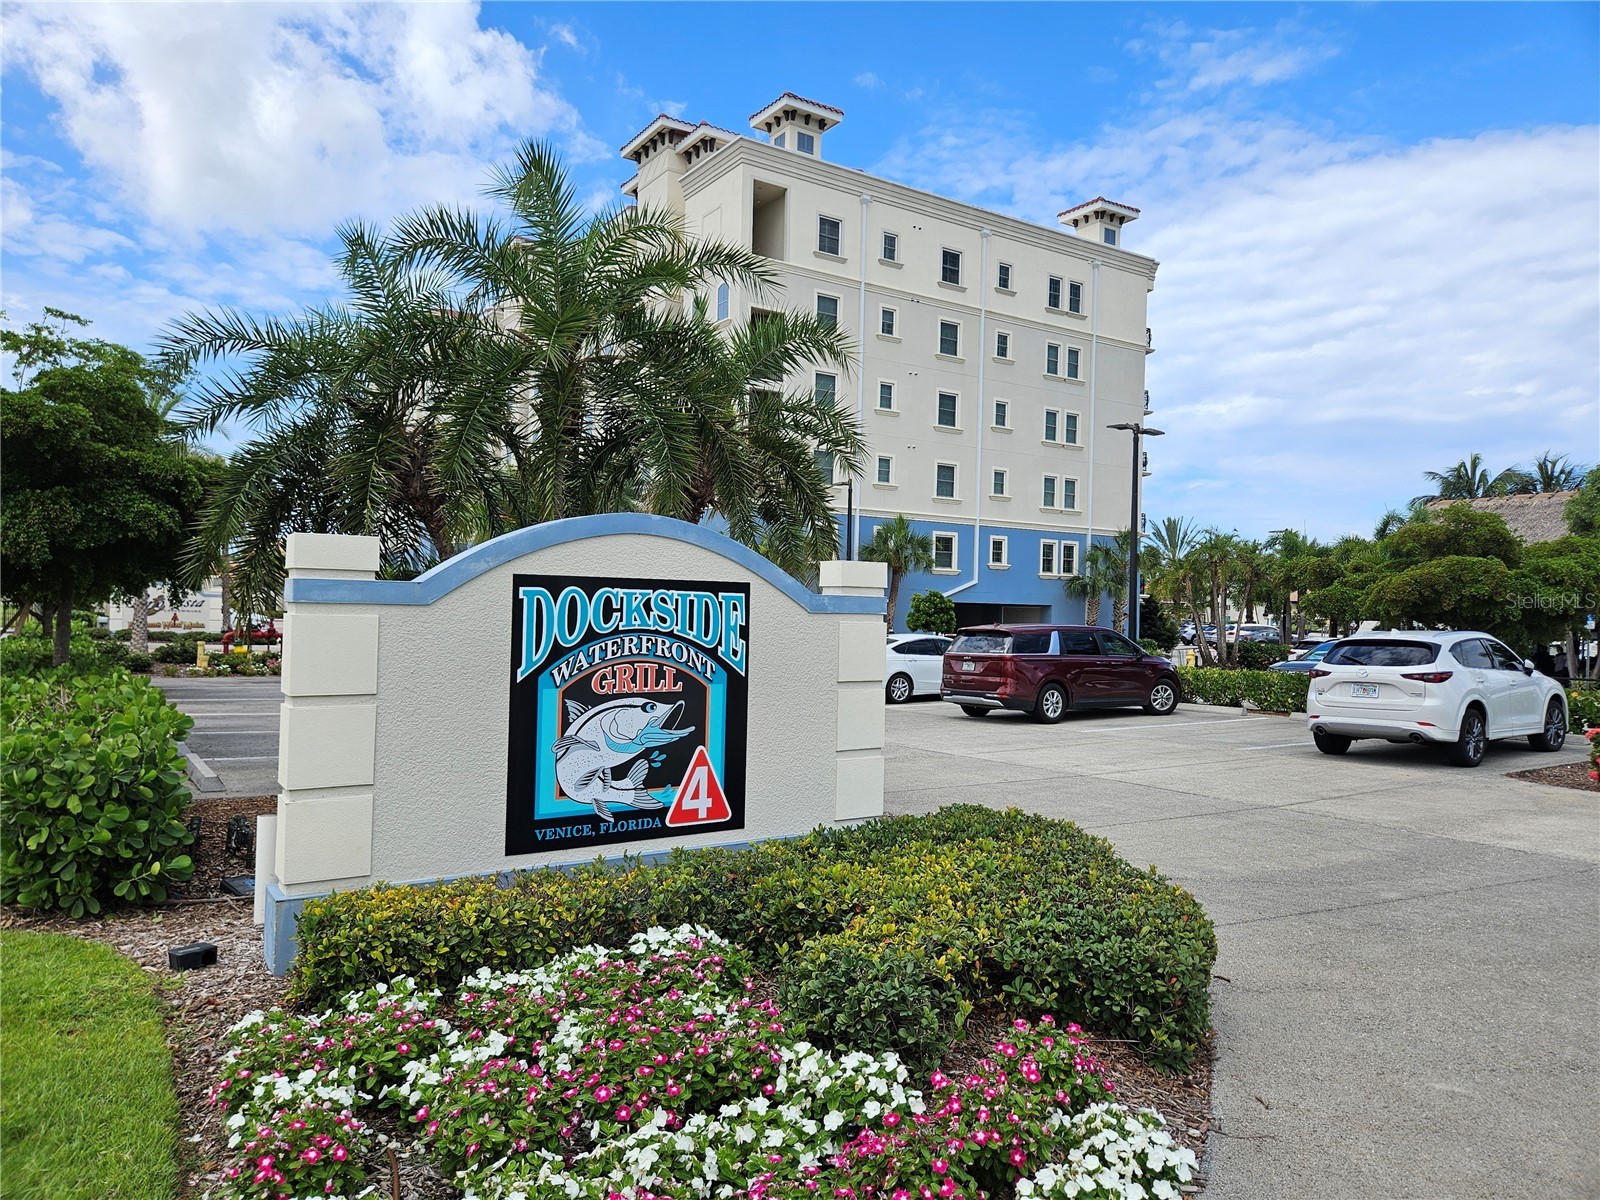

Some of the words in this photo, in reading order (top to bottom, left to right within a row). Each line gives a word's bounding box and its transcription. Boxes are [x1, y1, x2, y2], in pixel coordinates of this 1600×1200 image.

[516, 586, 746, 684] DOCKSIDE
[551, 634, 716, 687] WATERFRONT
[591, 663, 683, 694] GRILL
[681, 766, 713, 819] 4
[534, 824, 596, 841] VENICE,
[599, 817, 662, 834] FLORIDA
